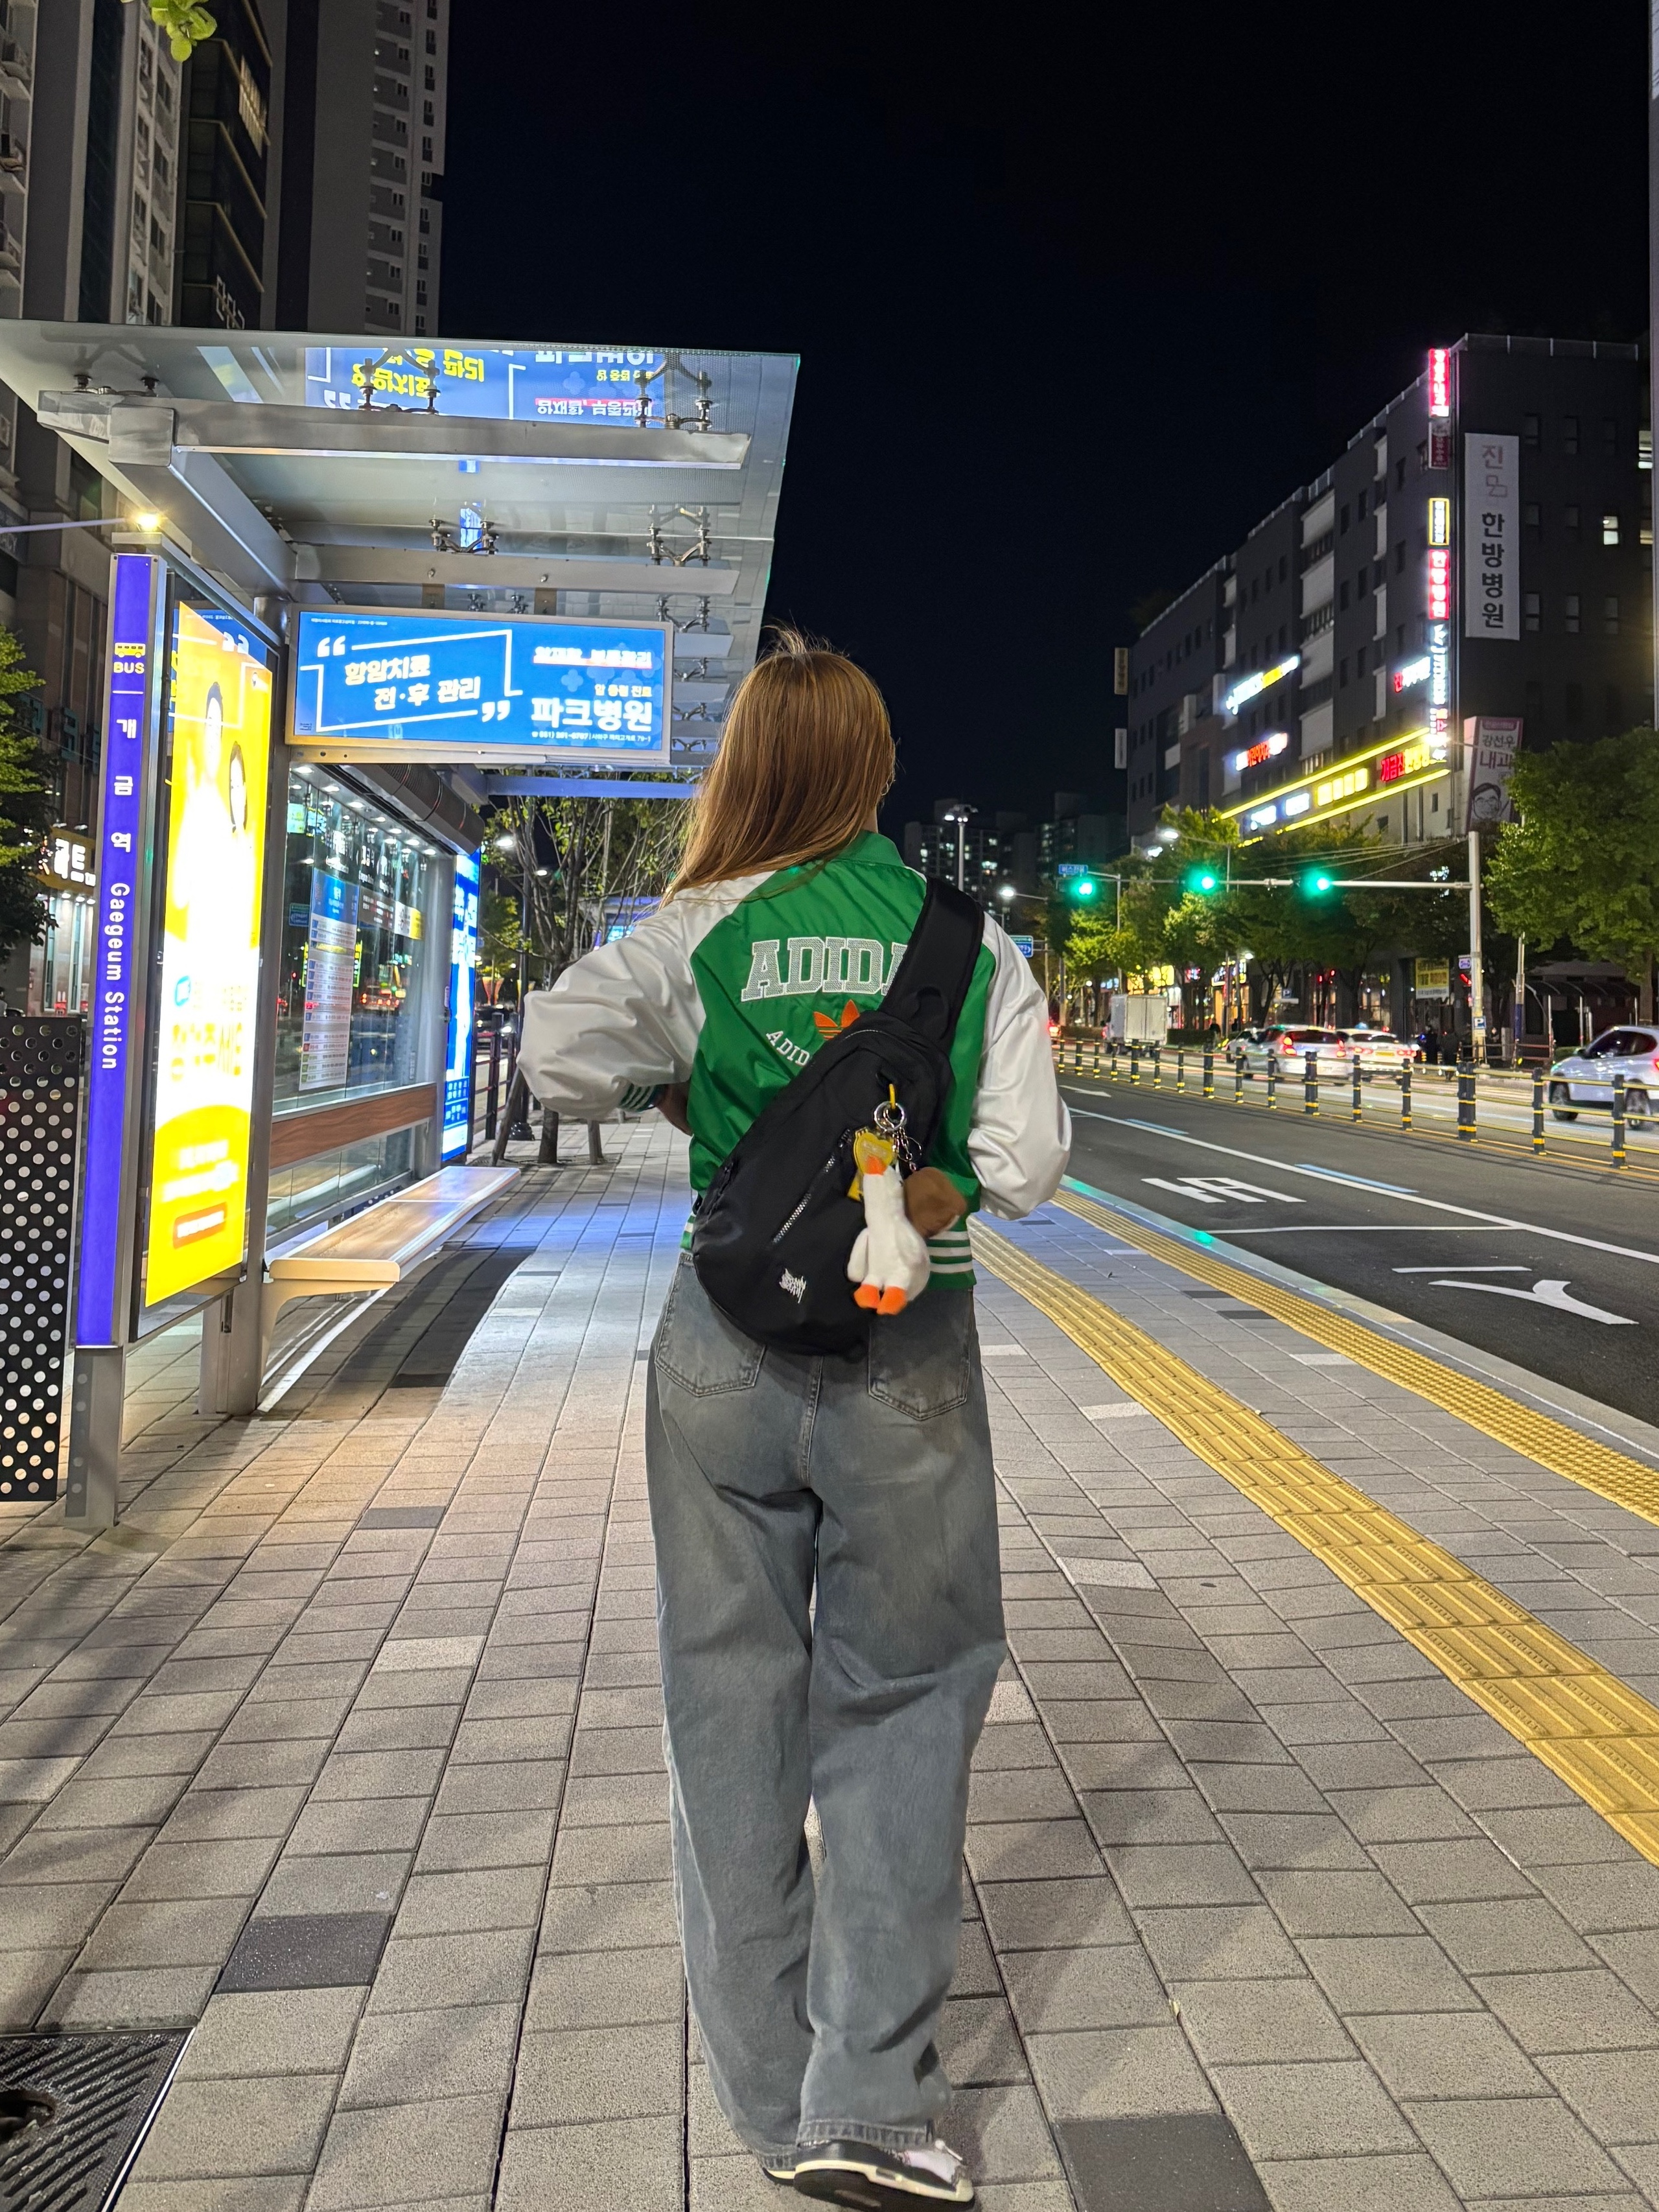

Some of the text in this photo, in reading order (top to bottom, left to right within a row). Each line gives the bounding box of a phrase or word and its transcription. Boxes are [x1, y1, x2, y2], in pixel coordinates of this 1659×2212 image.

[1481, 512, 1505, 629] 한방병원
[113, 662, 145, 674] BUS
[344, 655, 430, 686] 항암치료
[437, 677, 481, 704] 관리
[531, 697, 653, 732] 파크병원
[110, 718, 137, 853] 개금역
[101, 883, 130, 1069] Gaegeum Station
[1474, 1018, 1484, 1029] P
